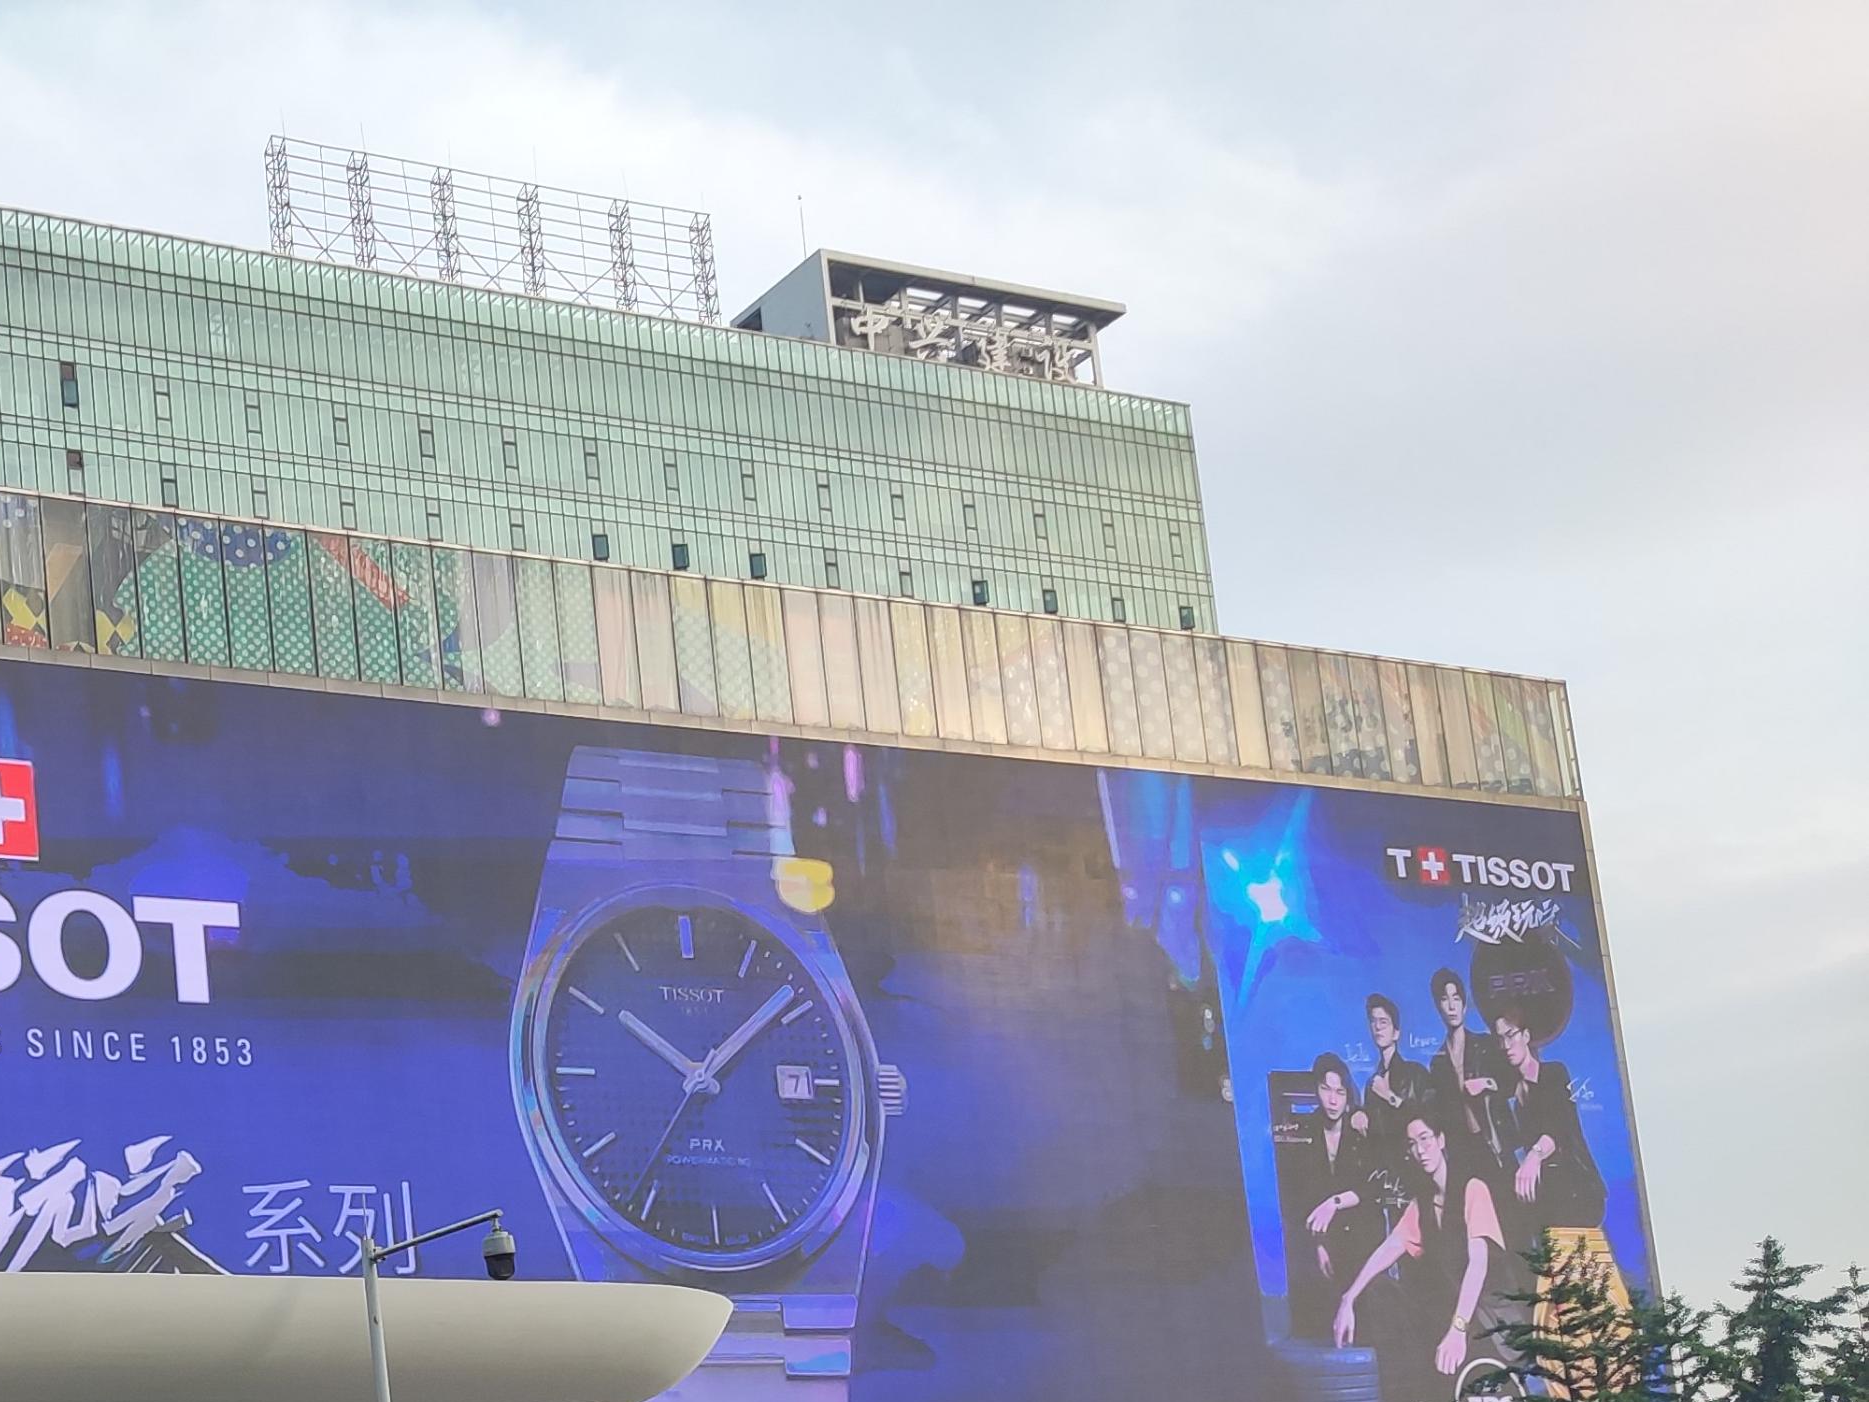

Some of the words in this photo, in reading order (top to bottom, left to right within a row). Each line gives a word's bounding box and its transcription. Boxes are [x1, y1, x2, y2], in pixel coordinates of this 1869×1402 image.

[1452, 853, 1576, 893] TISSOT
[659, 985, 725, 1004] TISSOT
[26, 1026, 148, 1063] SINCE
[169, 1032, 256, 1068] 1853
[690, 1138, 726, 1152] PRX
[240, 1178, 418, 1277] 系列
